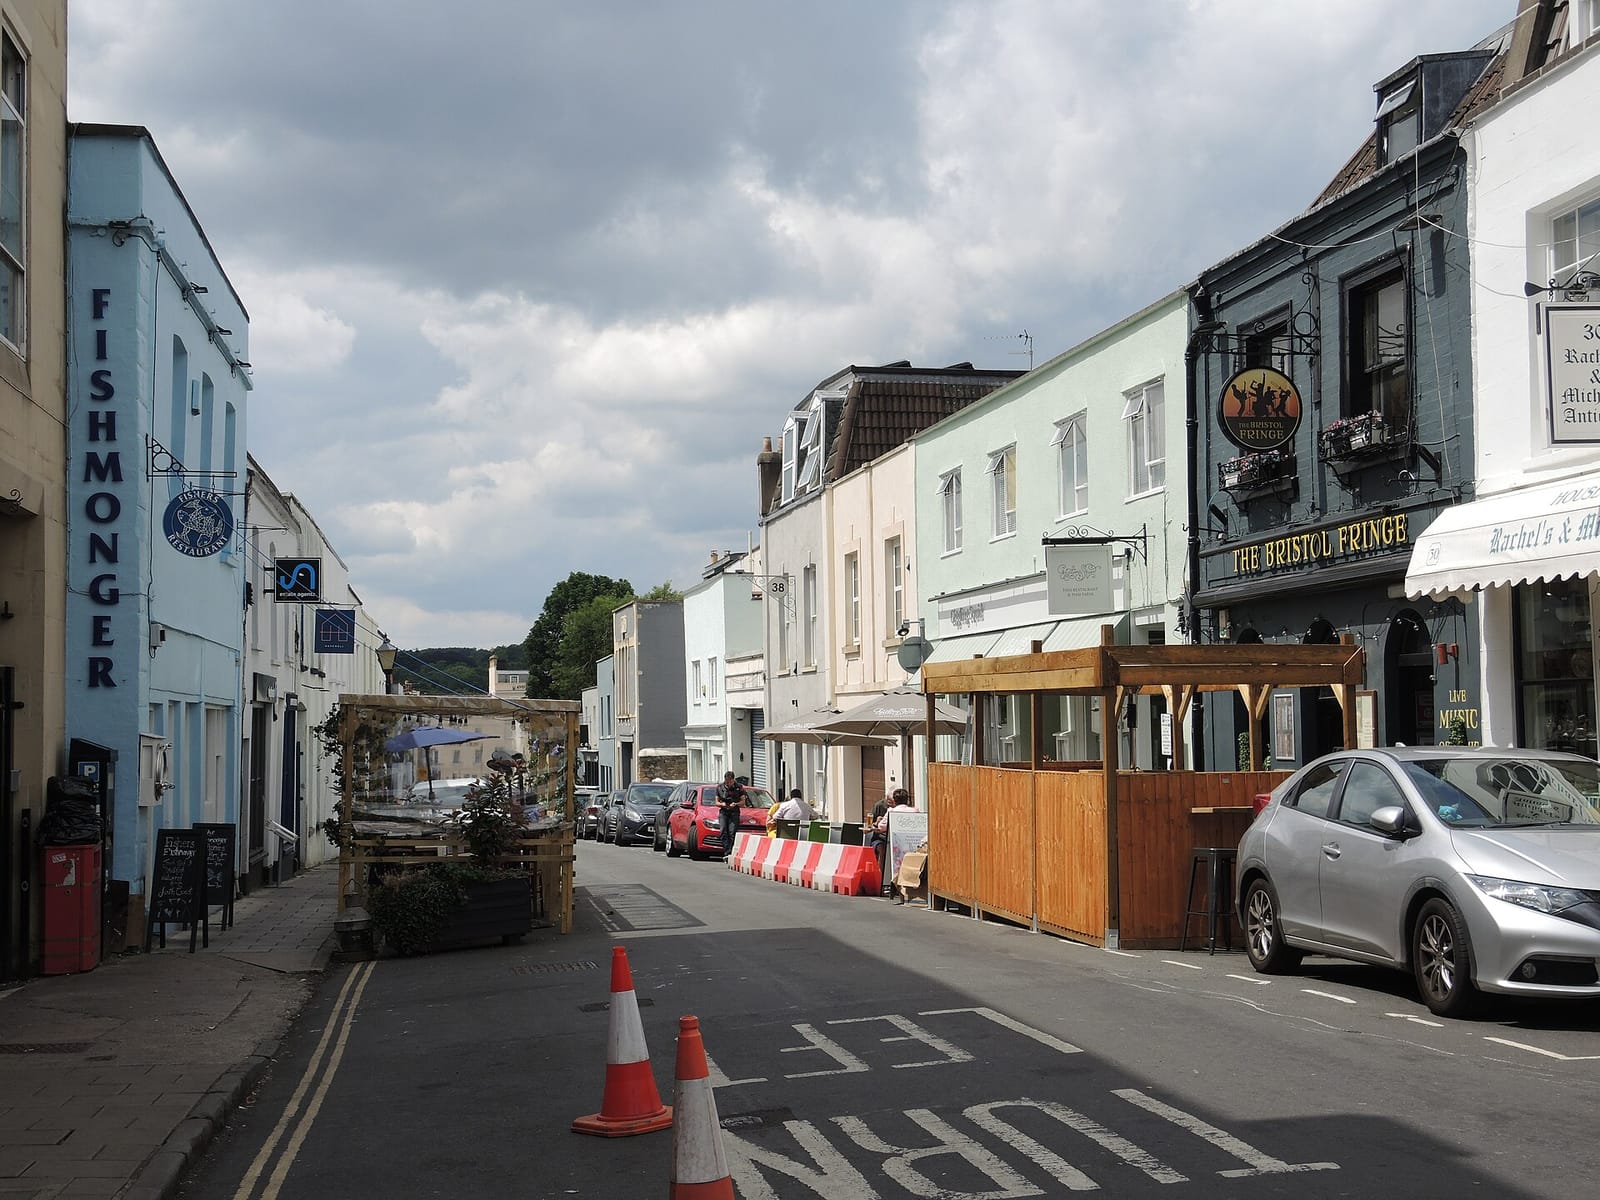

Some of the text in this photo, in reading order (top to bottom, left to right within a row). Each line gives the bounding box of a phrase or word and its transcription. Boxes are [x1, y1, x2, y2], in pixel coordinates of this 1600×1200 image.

[1563, 407, 1600, 424] Anti
[1250, 421, 1284, 429] BRISTOL
[1239, 429, 1285, 440] FRINGE
[84, 288, 124, 689] FISHMONGER
[177, 489, 220, 503] FISHERS
[1490, 519, 1553, 553] Rachel's
[1558, 516, 1572, 544] &
[167, 534, 228, 556] RESTAURANT
[1232, 513, 1408, 573] THE BRISTOL FRINGE
[771, 582, 785, 593] 38
[1448, 689, 1467, 703] LIVE
[83, 764, 97, 777] P
[721, 1088, 1341, 1200] TURN
